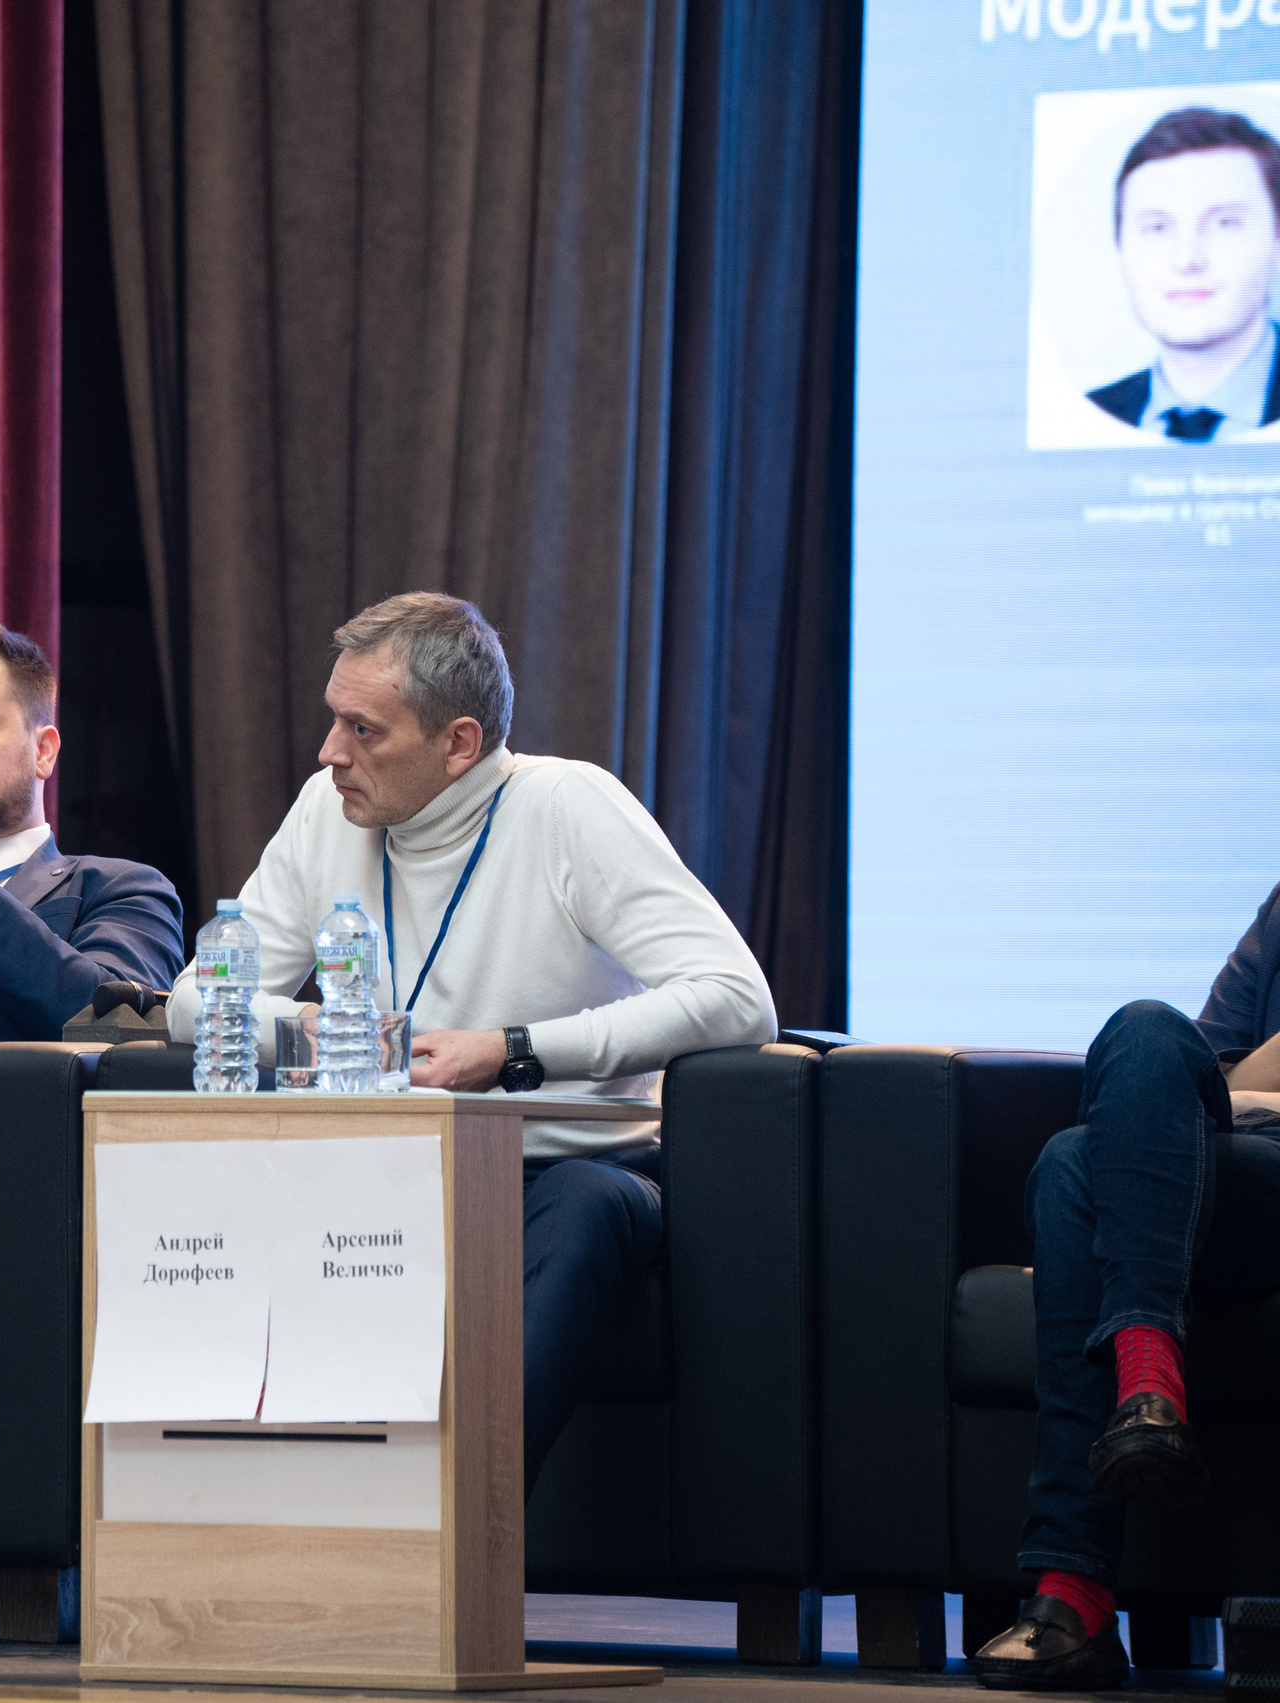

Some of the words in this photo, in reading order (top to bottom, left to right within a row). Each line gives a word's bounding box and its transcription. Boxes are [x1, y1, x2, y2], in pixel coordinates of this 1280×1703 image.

[155, 1234, 223, 1255] Андрей
[323, 1230, 402, 1252] Арсений
[144, 1264, 234, 1285] Дорофеев
[323, 1262, 403, 1278] Величко
